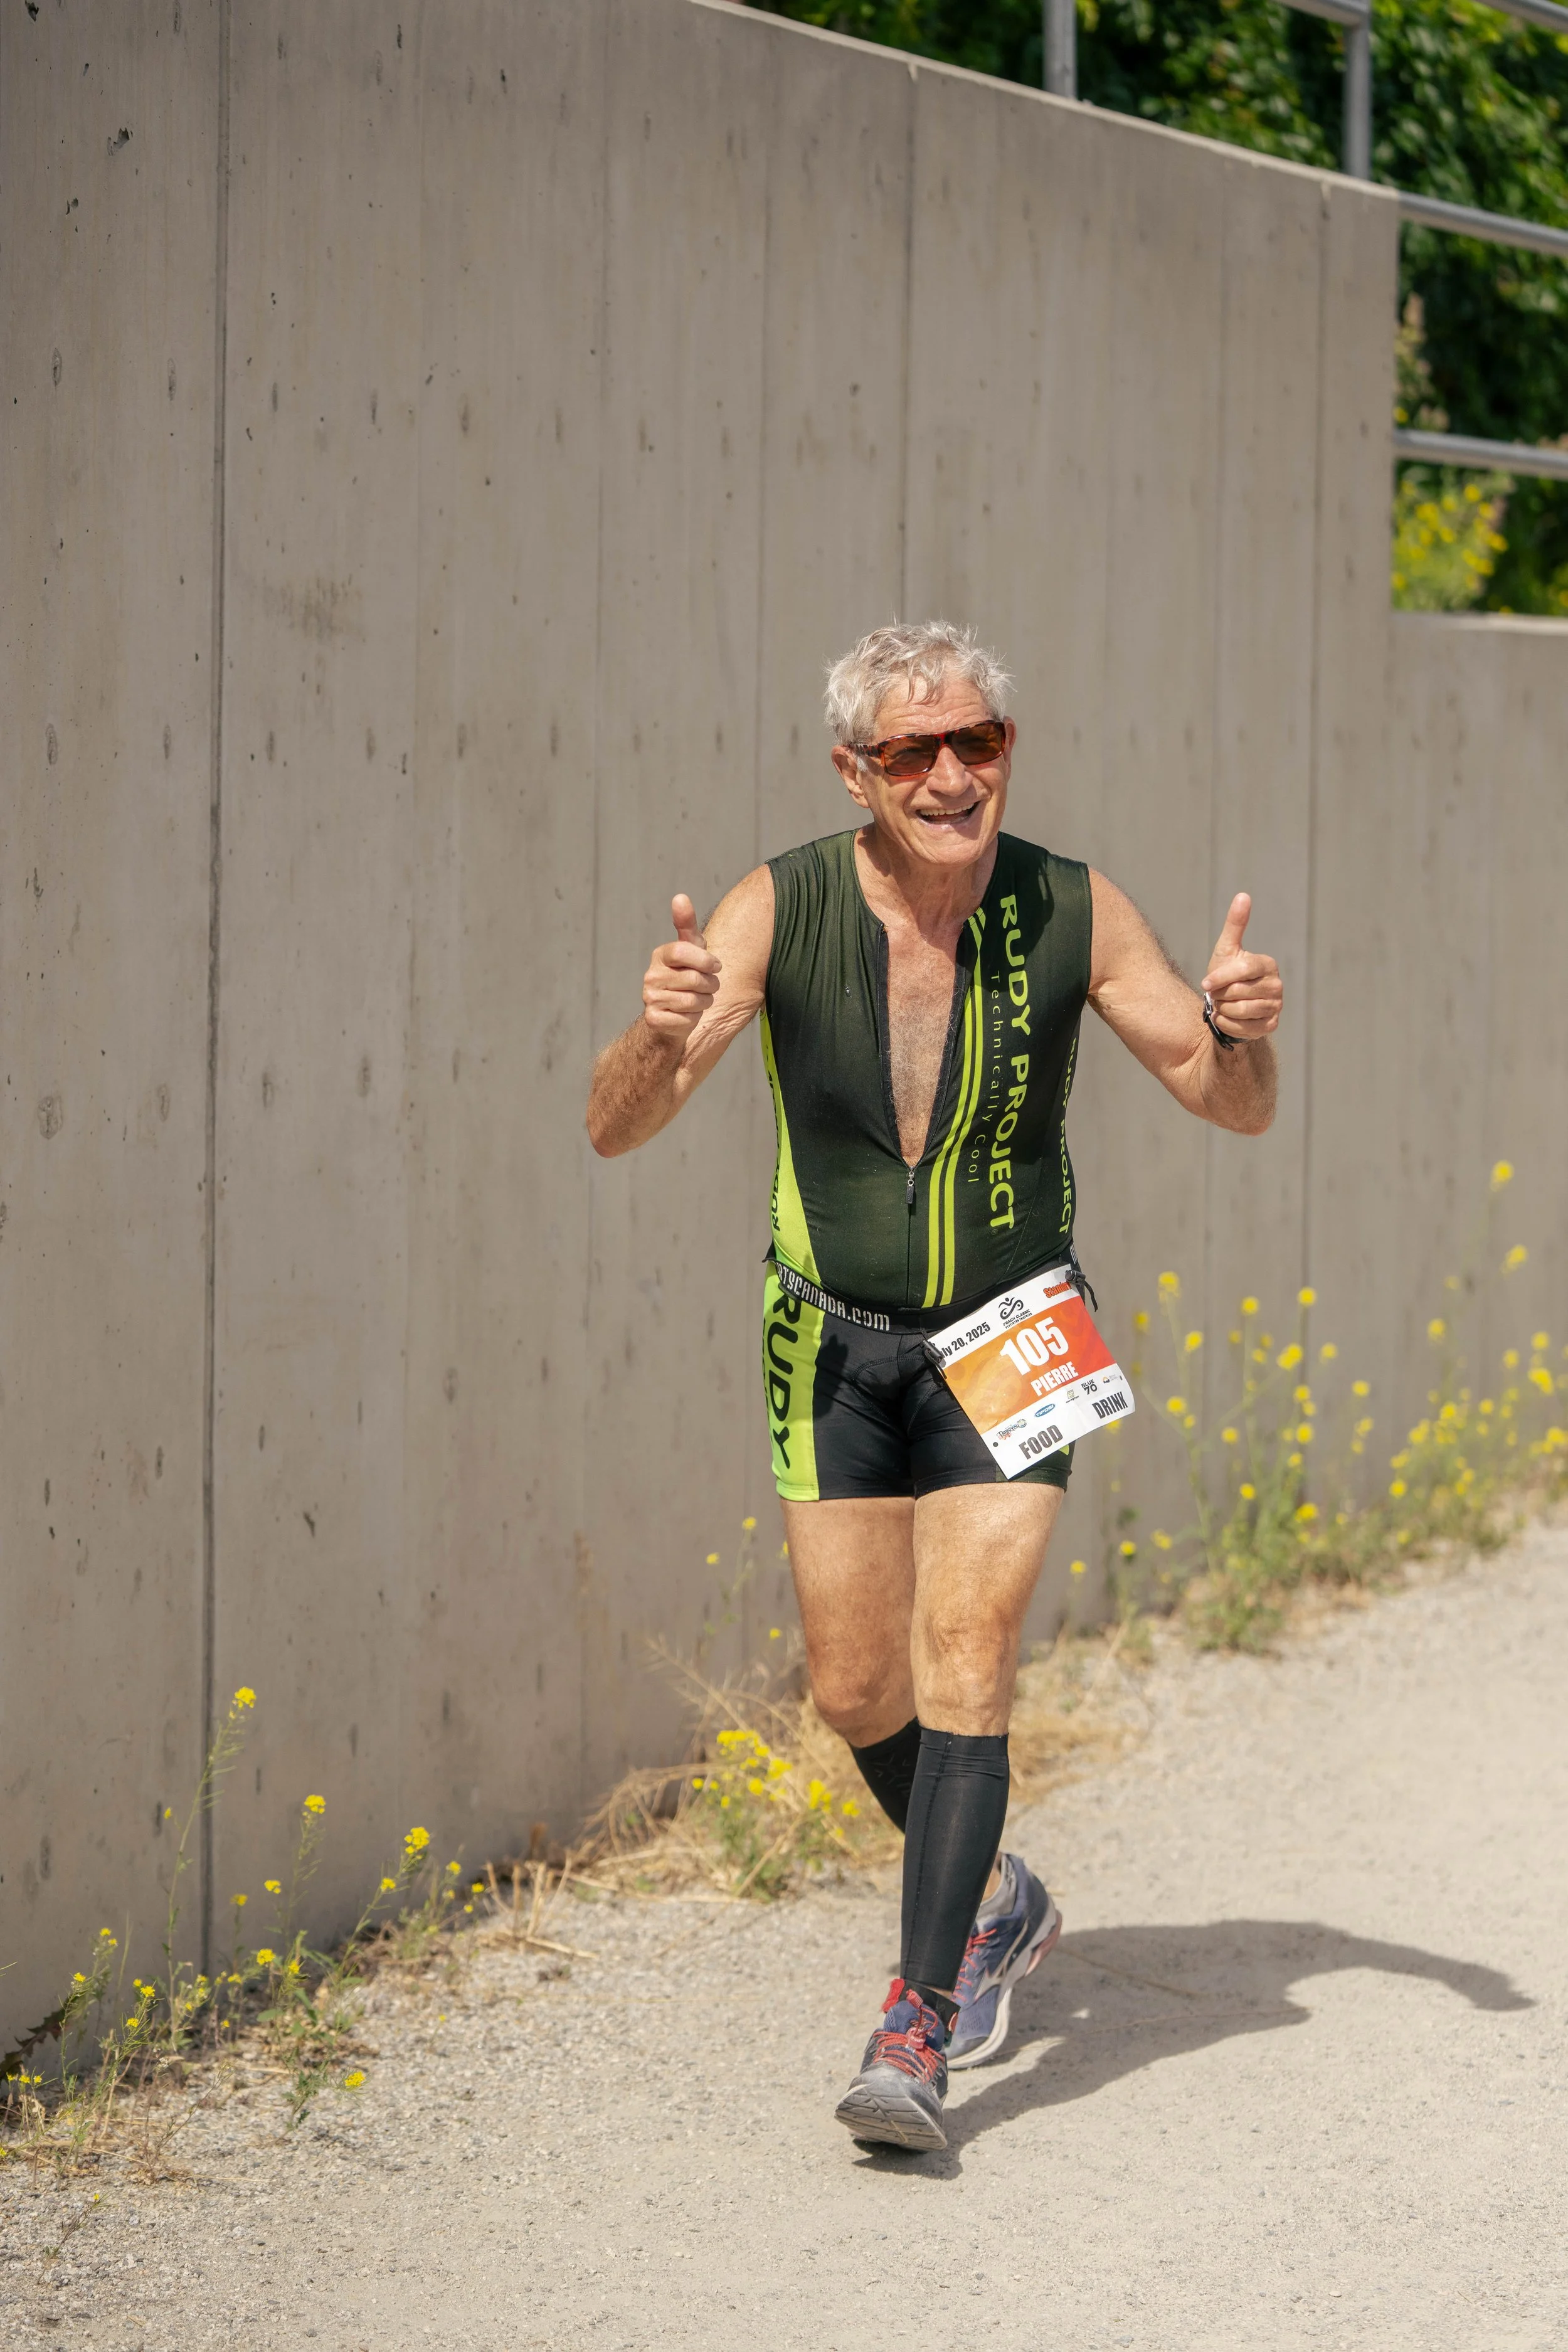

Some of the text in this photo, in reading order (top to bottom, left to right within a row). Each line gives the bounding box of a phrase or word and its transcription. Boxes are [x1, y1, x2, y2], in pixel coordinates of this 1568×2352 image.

[982, 970, 1004, 1121] Technically
[990, 894, 1030, 1229] RUDY PROJECT
[1059, 1118, 1072, 1234] PROJECT
[1003, 1309, 1030, 1327] PEACH CLASSIC
[951, 1337, 968, 1351] 20,
[965, 1322, 991, 1342] 2025
[999, 1316, 1069, 1375] 105
[767, 1293, 802, 1469] RUDY
[1030, 1361, 1079, 1397] PIERRE
[1081, 1379, 1094, 1388] BLUE
[1084, 1384, 1098, 1395] 70
[1091, 1391, 1128, 1419] DRINK
[1019, 1424, 1063, 1460] FOOD
